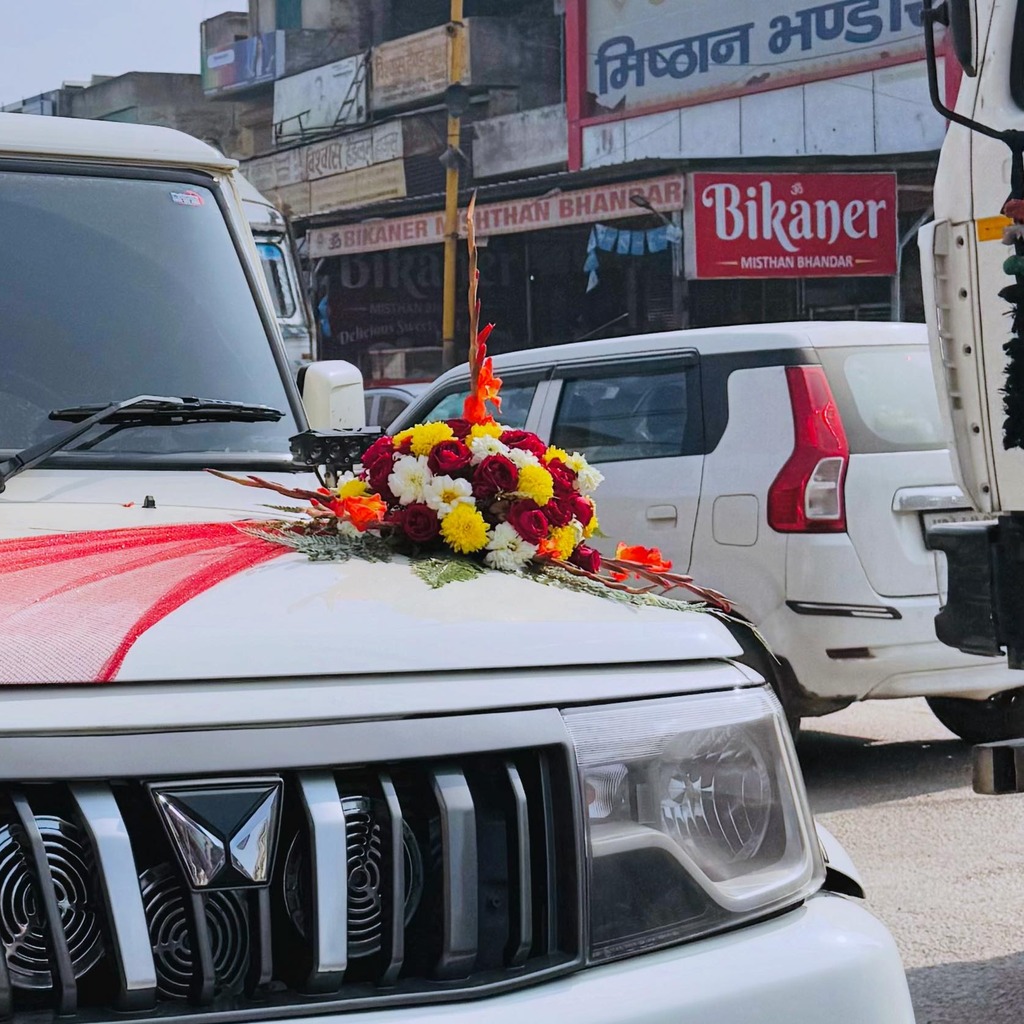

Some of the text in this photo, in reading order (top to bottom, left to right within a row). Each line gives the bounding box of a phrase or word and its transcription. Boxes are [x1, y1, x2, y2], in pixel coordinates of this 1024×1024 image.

[595, 22, 754, 95] मिष्ठान
[344, 219, 428, 247] BIKANER
[559, 181, 681, 218] BHANDAR
[702, 181, 886, 252] Bikaner
[740, 255, 854, 269] MISTHAN BHANDAR
